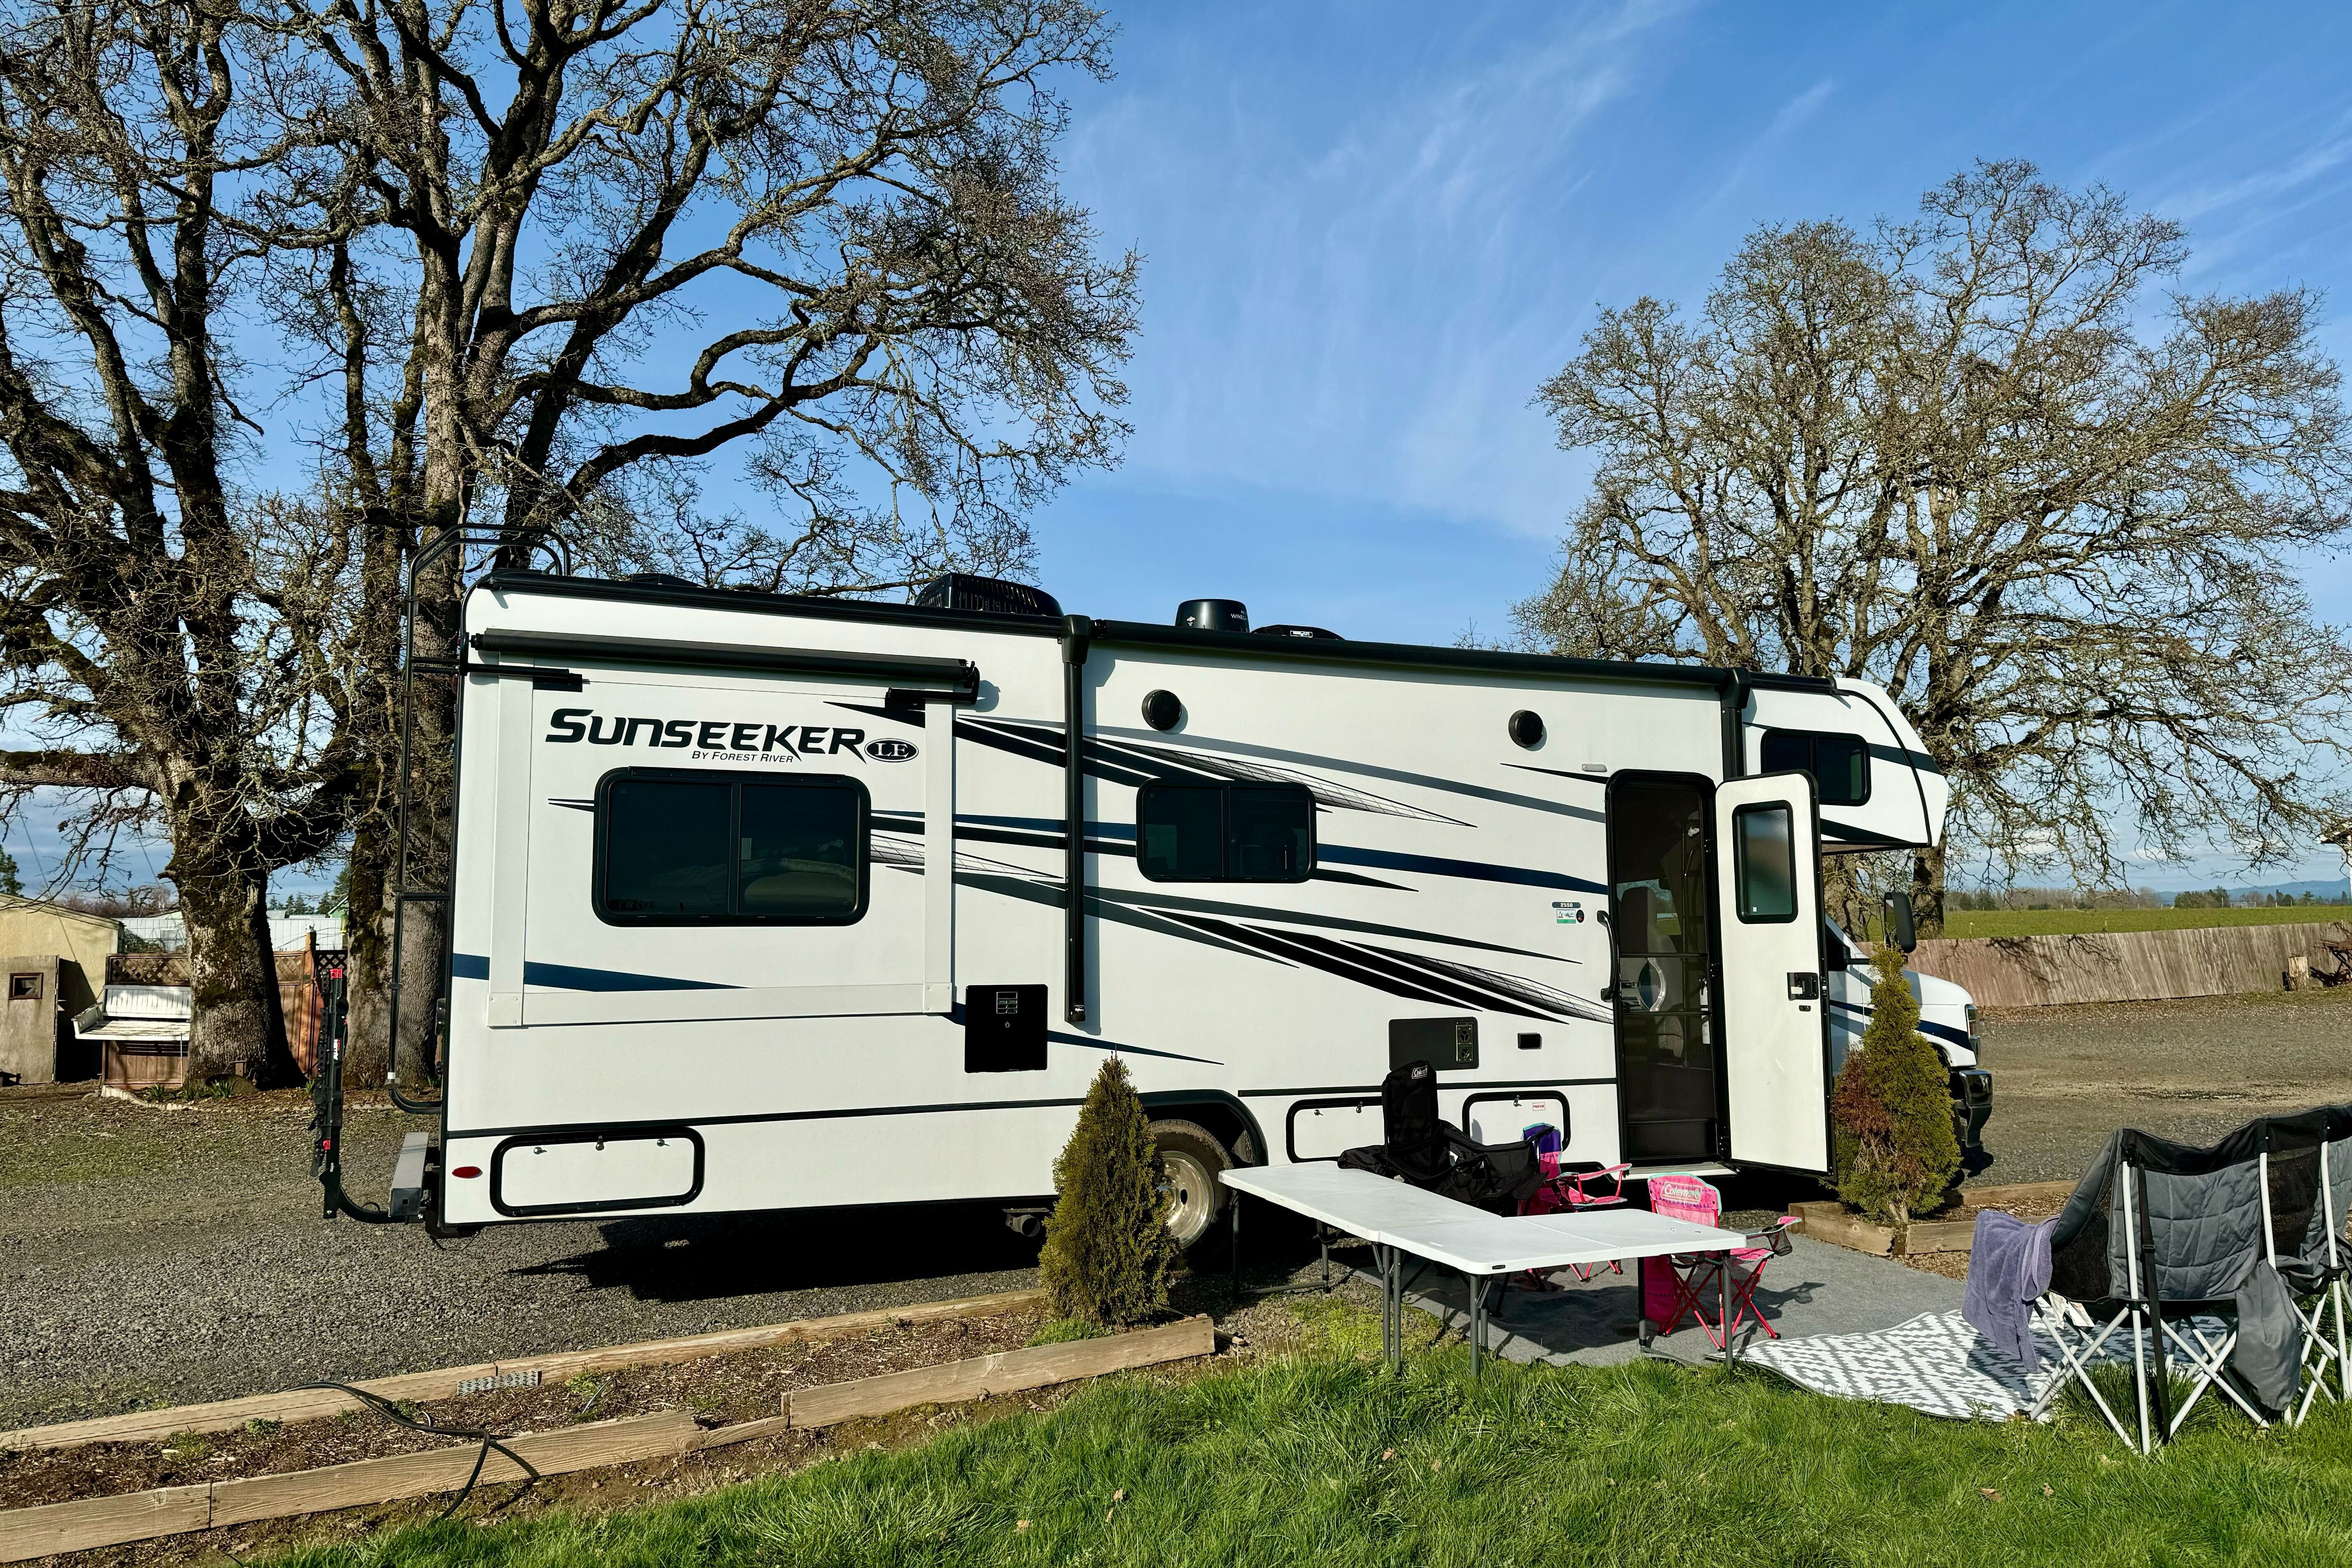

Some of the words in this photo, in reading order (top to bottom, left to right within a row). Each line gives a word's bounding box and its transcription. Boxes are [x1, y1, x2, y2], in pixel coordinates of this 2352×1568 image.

[545, 708, 867, 765] SUNSEEKER
[692, 751, 709, 759] BY
[712, 751, 758, 761] FOREST
[761, 754, 793, 763] RIVER
[873, 742, 910, 758] LE
